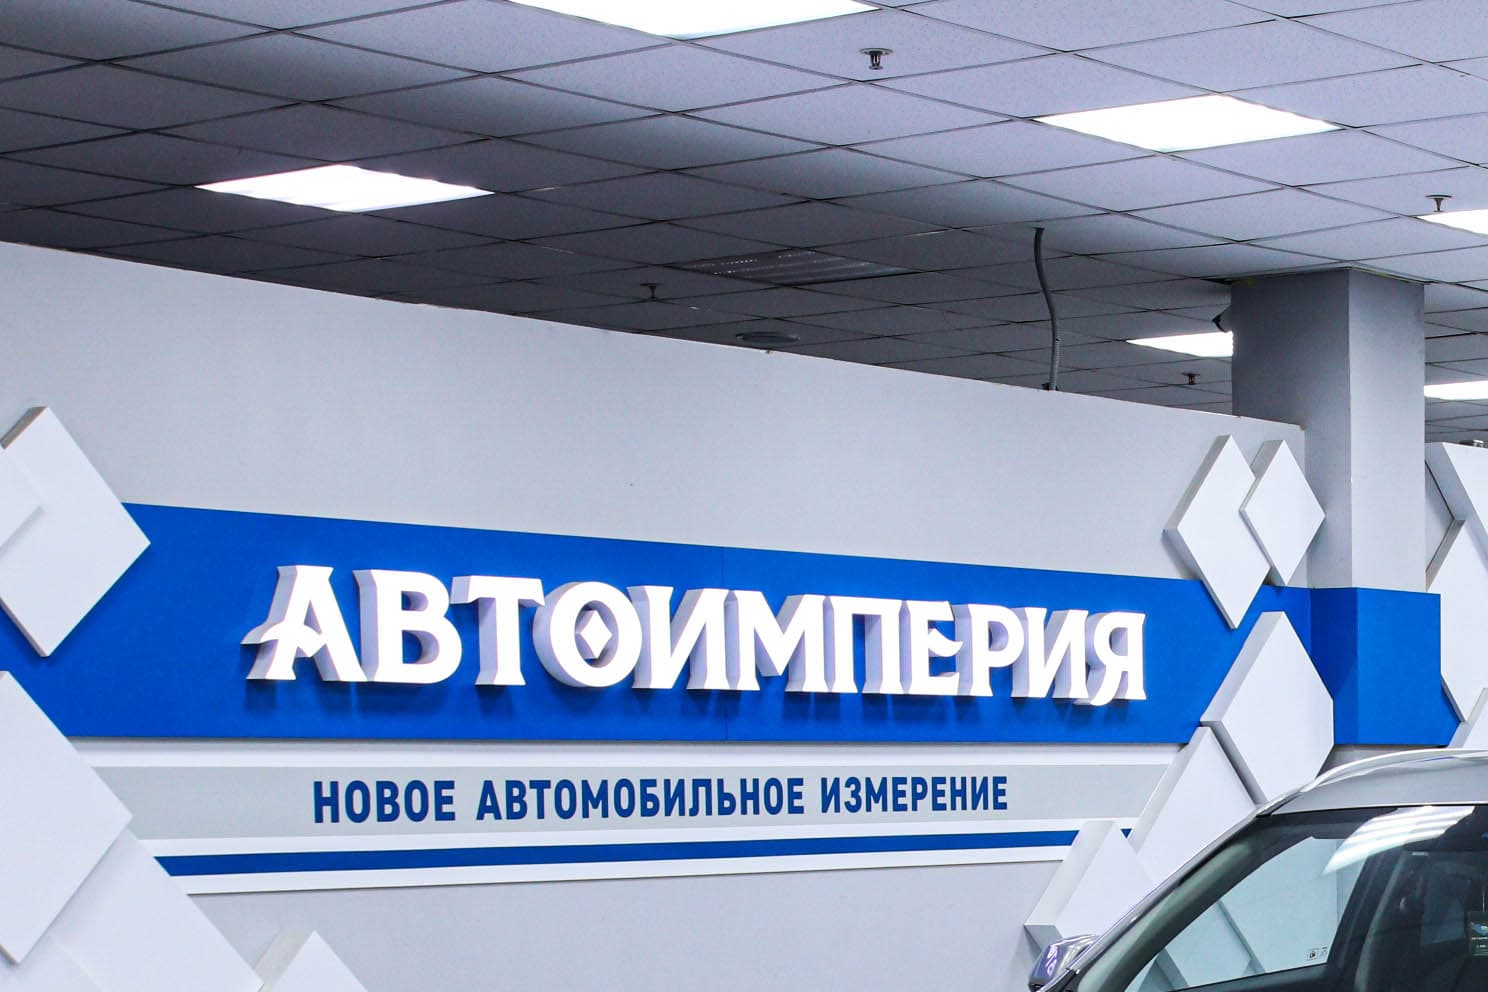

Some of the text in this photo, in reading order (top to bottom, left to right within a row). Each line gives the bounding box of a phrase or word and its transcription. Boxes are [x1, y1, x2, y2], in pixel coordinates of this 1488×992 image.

[242, 565, 1147, 706] АВТОИМПЕРИЯ
[314, 775, 1009, 824] НОВОЕ АВТОМОБИЛЬНОЕ ИЗМЕРЕНИЕ
